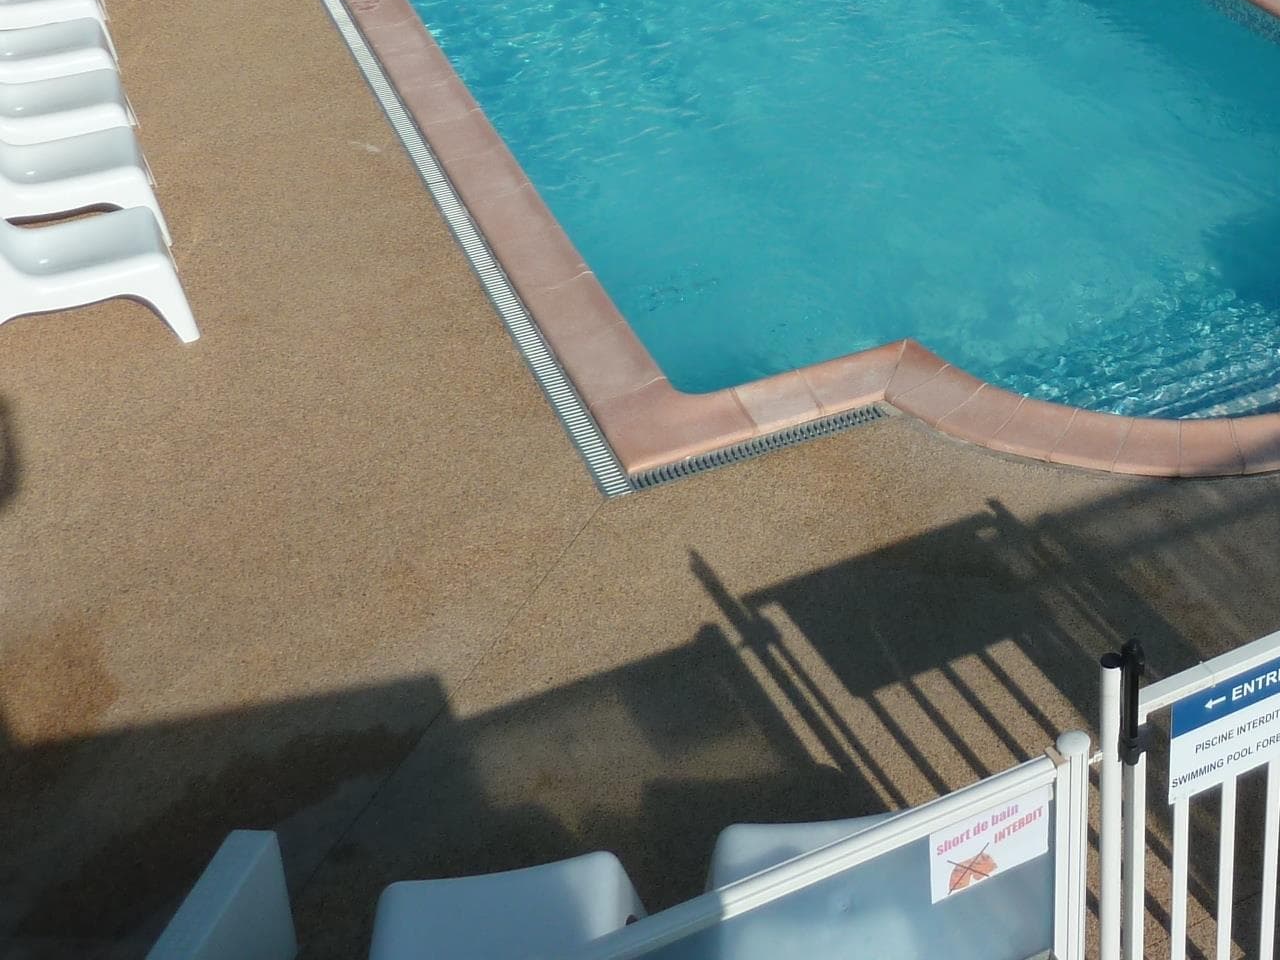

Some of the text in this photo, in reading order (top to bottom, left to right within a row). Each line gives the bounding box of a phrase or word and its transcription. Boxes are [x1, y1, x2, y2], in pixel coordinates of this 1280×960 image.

[1195, 729, 1234, 754] PISCINE
[1171, 759, 1224, 788] SWIMMING
[1226, 745, 1253, 765] POOL
[936, 804, 1019, 856] short de bain
[994, 805, 1043, 844] INTERDIT
